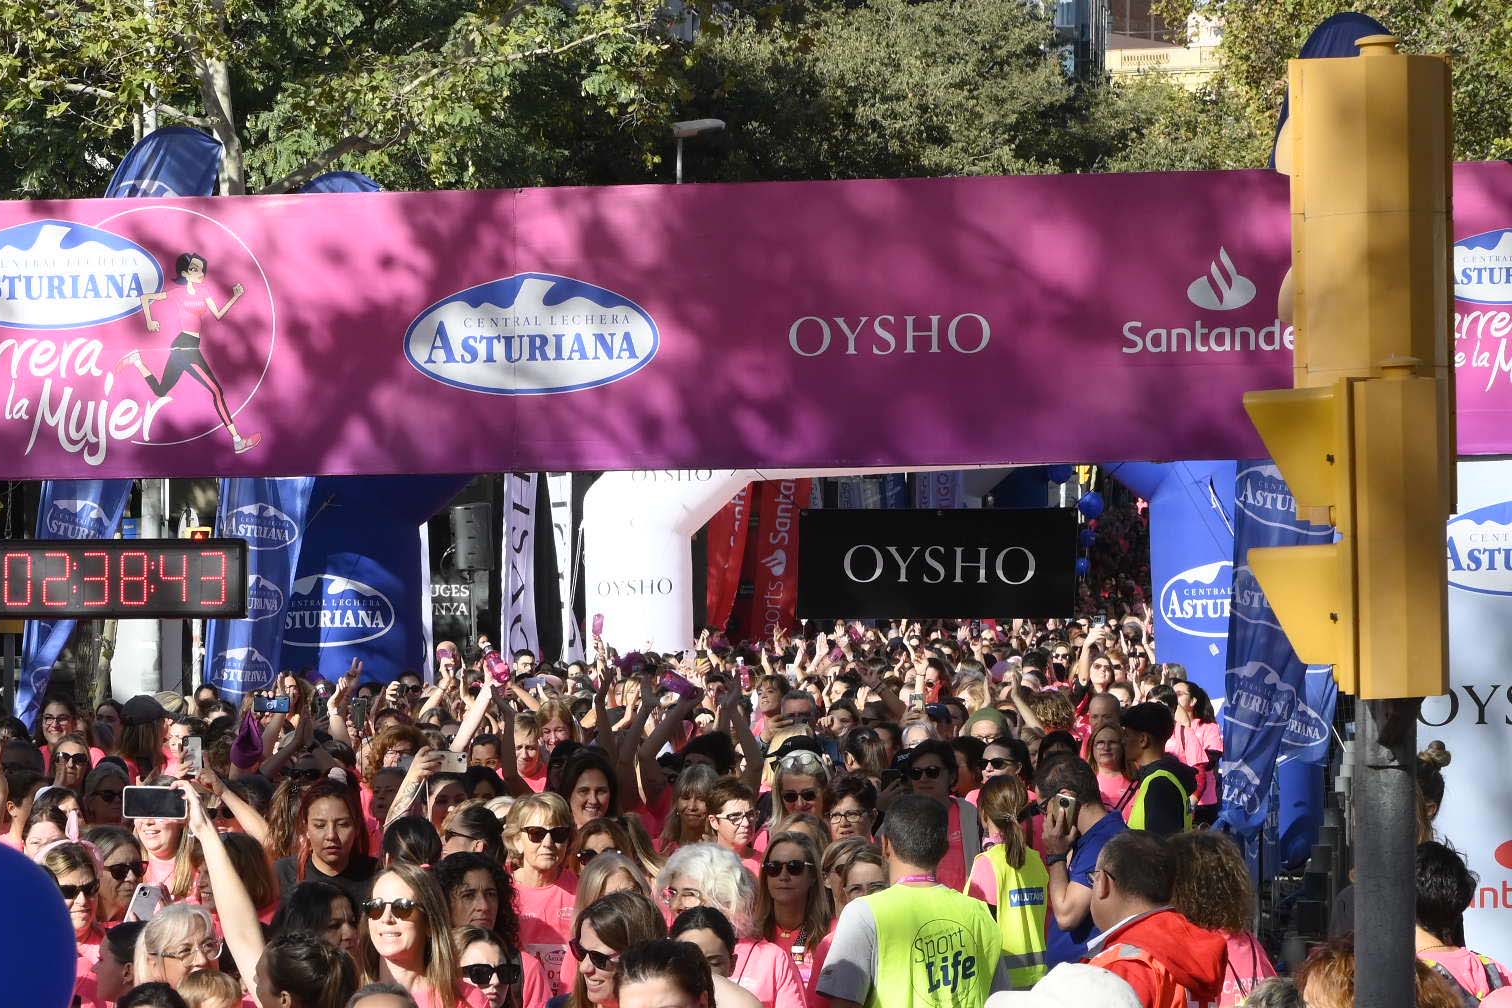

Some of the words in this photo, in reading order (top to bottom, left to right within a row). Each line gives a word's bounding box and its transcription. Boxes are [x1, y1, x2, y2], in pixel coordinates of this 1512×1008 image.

[463, 314, 542, 329] CENTRAL
[549, 312, 631, 327] LECHERA
[788, 312, 991, 357] OYSHO
[1122, 316, 1295, 354] Santande
[424, 320, 640, 364] ASTURIANA
[4, 380, 29, 420] la
[25, 371, 173, 466] Mujer
[3, 552, 226, 606] 02:38:43
[509, 472, 531, 654] OYSH
[843, 544, 1037, 586] OYSHO
[289, 599, 328, 607] ENTRAL
[597, 576, 673, 597] OYSHO
[285, 609, 385, 629] STURIANA
[914, 927, 966, 964] Sport
[925, 950, 976, 994] Life
